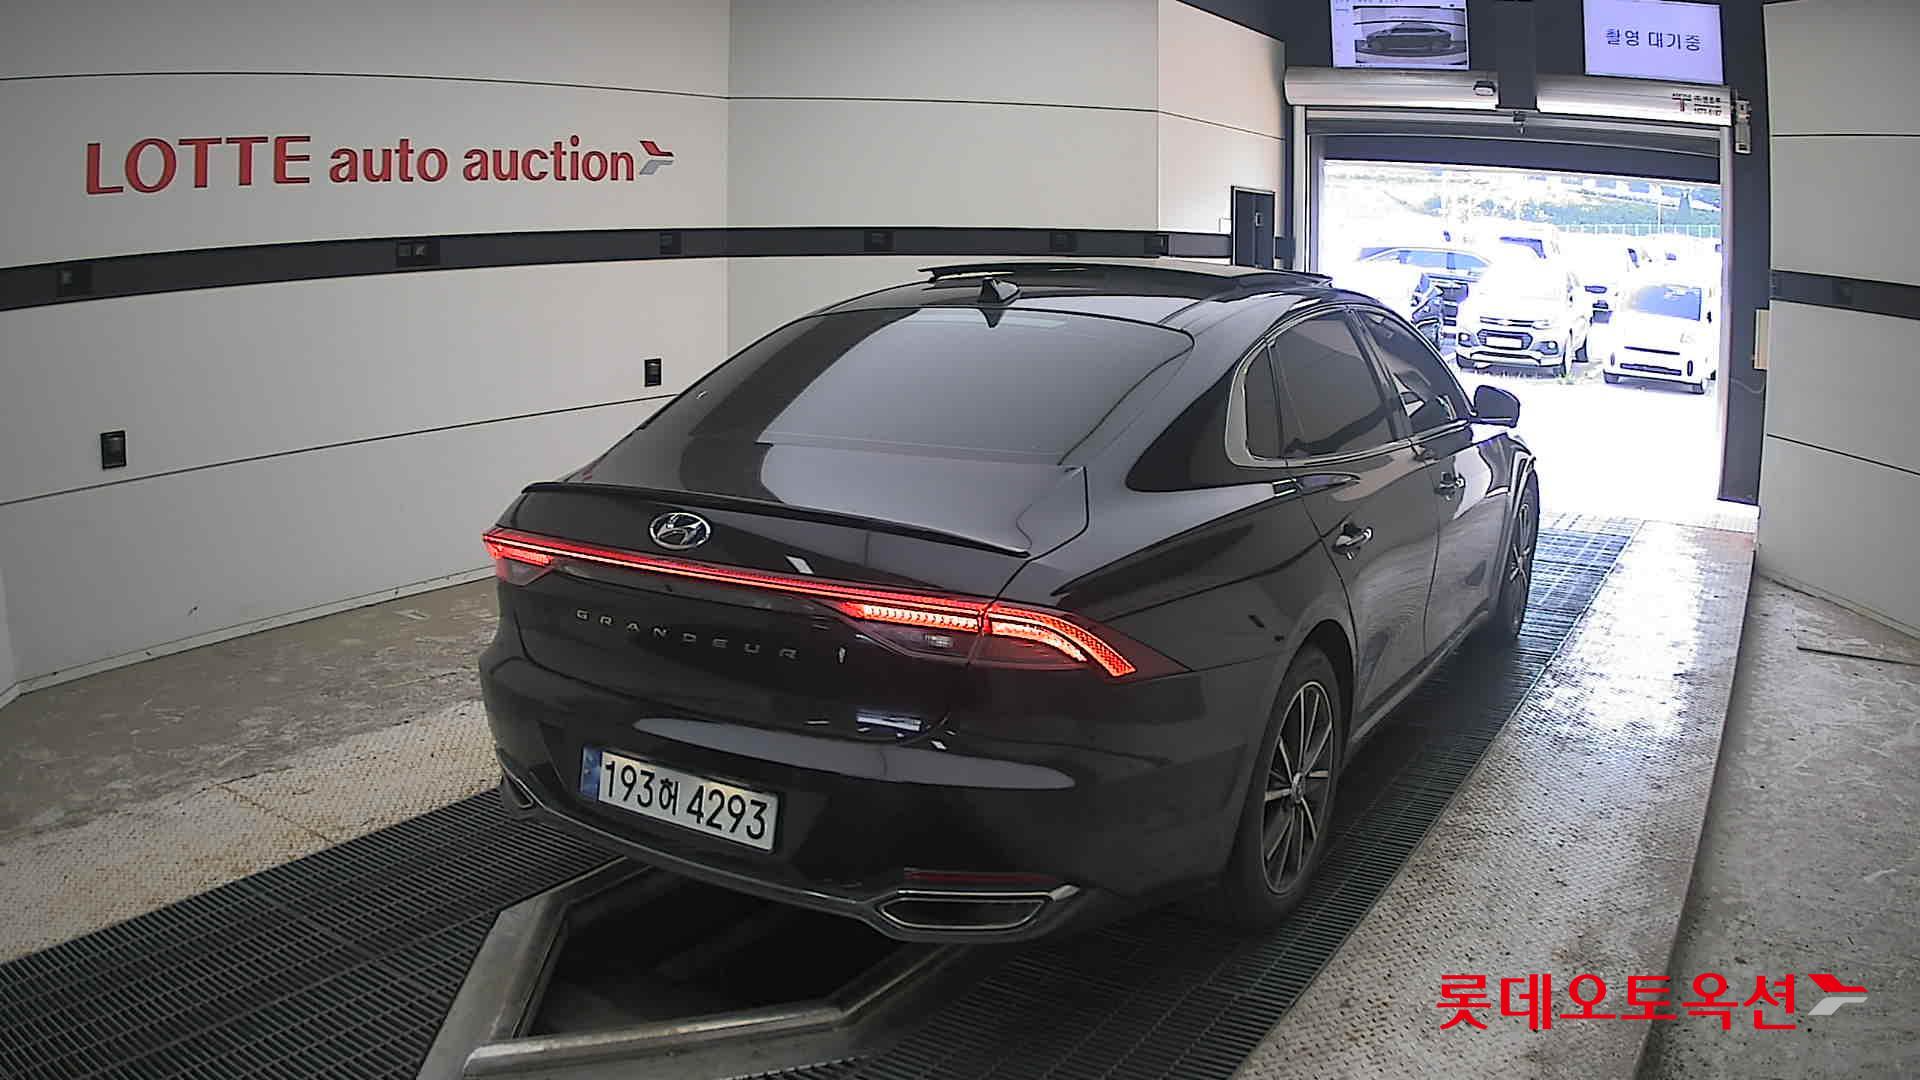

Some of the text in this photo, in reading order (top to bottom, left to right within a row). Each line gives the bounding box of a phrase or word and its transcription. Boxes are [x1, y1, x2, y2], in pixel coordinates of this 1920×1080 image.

[1606, 28, 1701, 52] 촬영 대기중
[86, 135, 636, 195] LOTTE auto auction
[575, 608, 798, 660] GRANDEUR
[604, 760, 768, 840] 193허 4293
